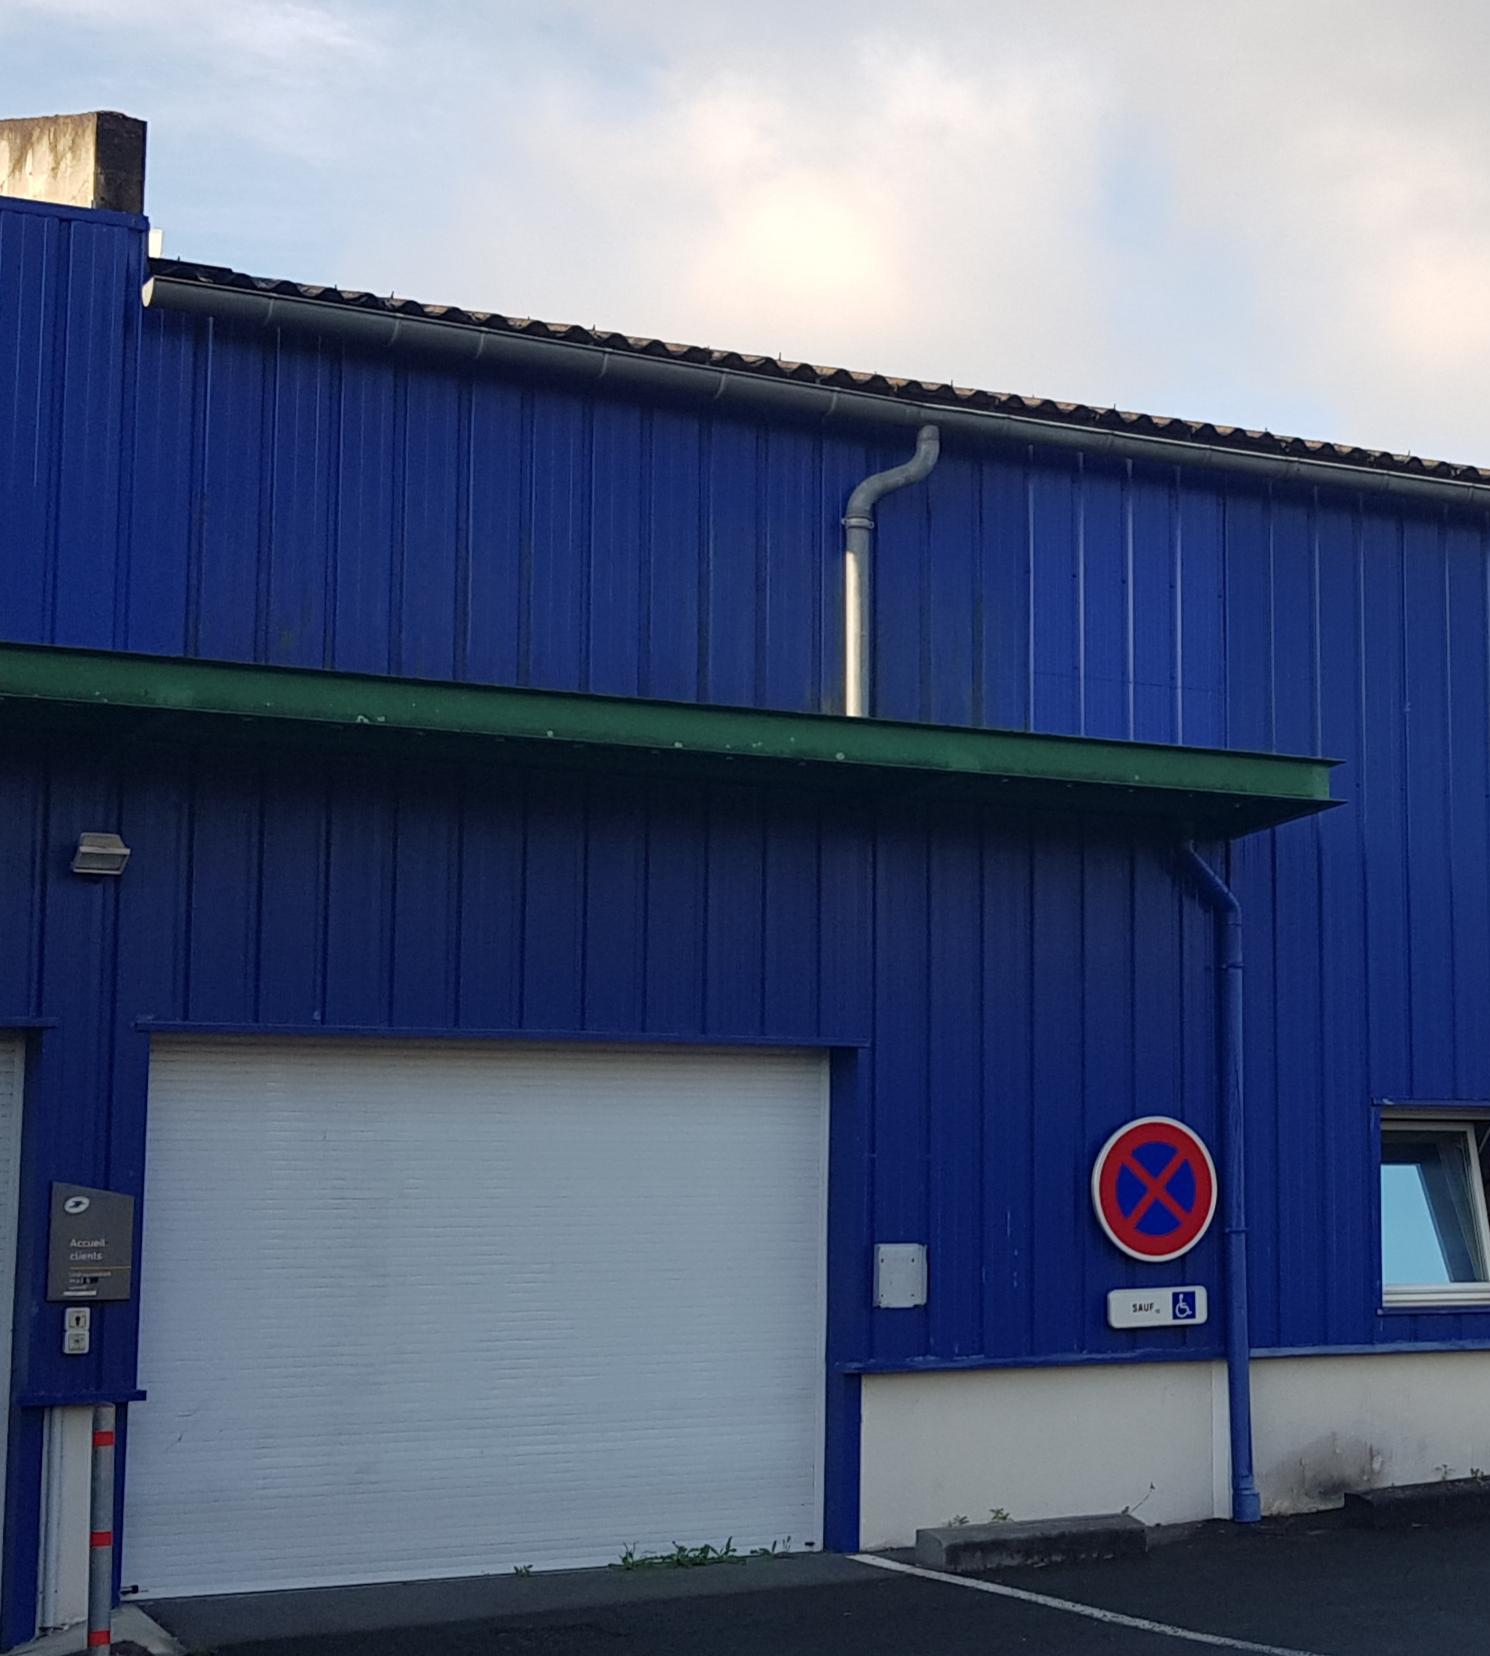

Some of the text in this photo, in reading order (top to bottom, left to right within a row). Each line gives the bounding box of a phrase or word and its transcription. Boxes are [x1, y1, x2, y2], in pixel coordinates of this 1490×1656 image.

[70, 1238, 106, 1248] Accueil
[70, 1252, 103, 1261] clients
[1132, 1302, 1154, 1313] SAUF
